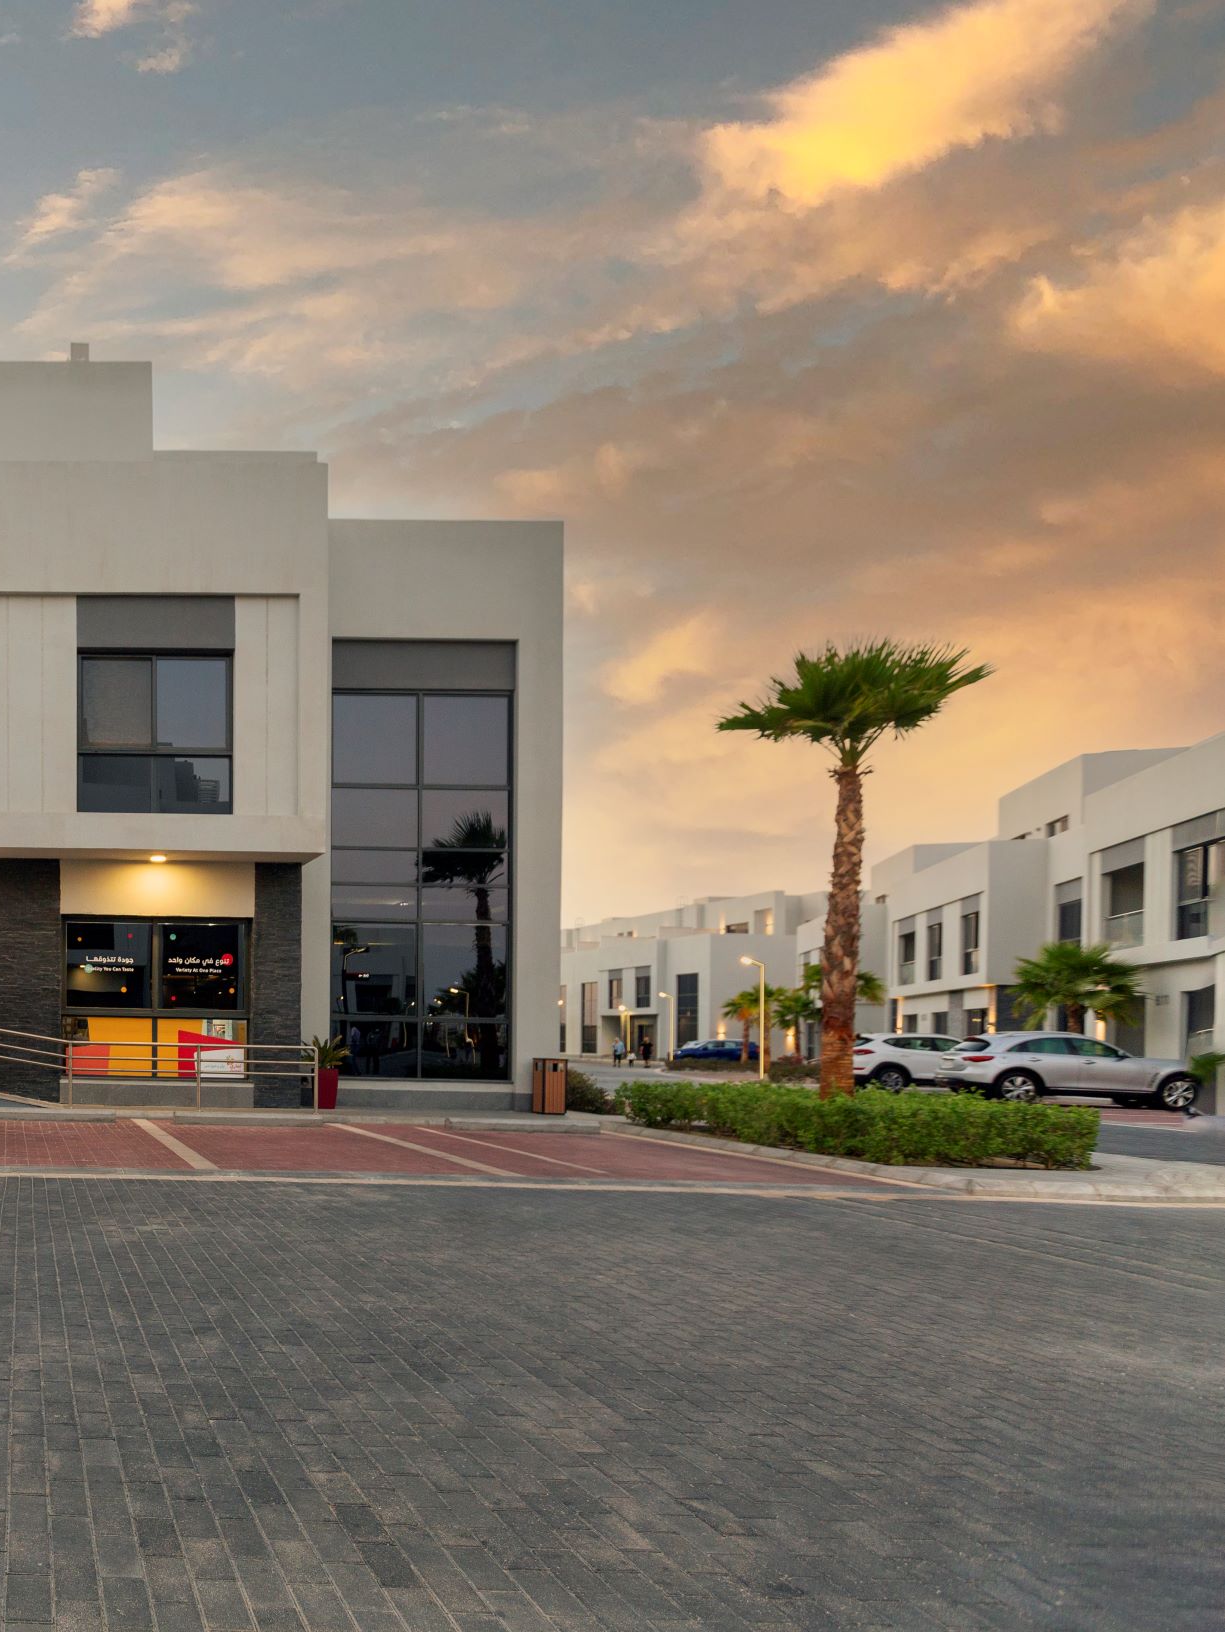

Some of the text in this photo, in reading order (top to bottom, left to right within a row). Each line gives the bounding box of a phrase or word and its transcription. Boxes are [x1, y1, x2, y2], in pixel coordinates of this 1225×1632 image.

[117, 956, 134, 965] جودة
[167, 956, 230, 967] تنوع في مكان واحد
